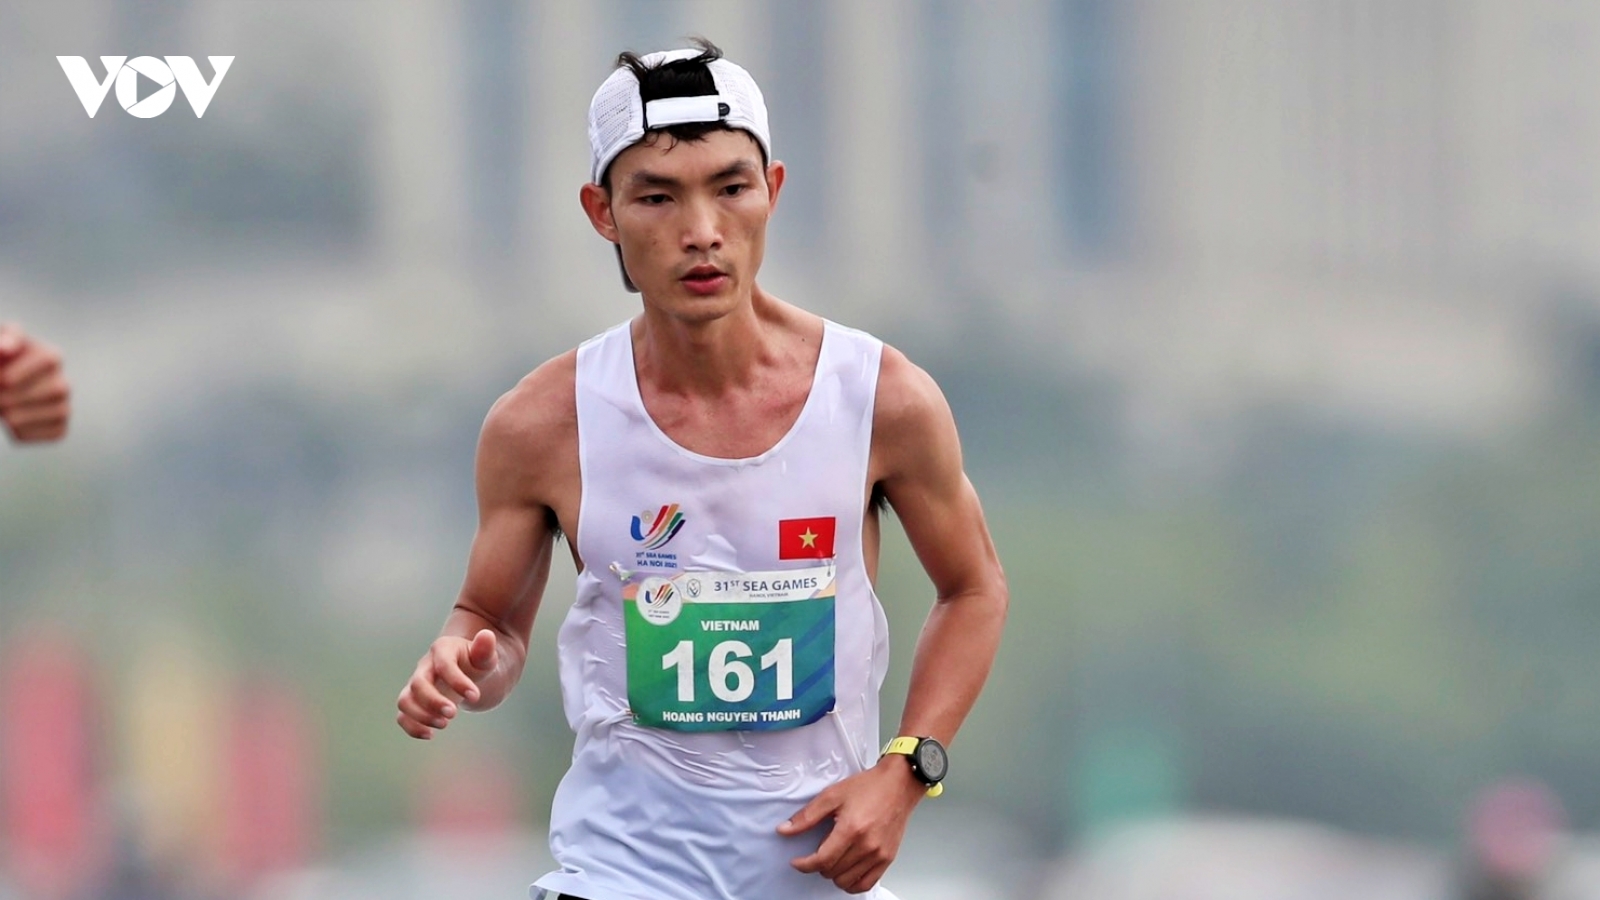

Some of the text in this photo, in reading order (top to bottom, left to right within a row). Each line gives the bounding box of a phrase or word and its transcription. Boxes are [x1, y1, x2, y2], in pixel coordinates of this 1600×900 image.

[714, 577, 817, 592] 31ST SEA GAMES
[701, 620, 760, 631] VIETNAM
[662, 638, 793, 702] 161
[662, 709, 801, 722] HOANG NGUYEN THANH
